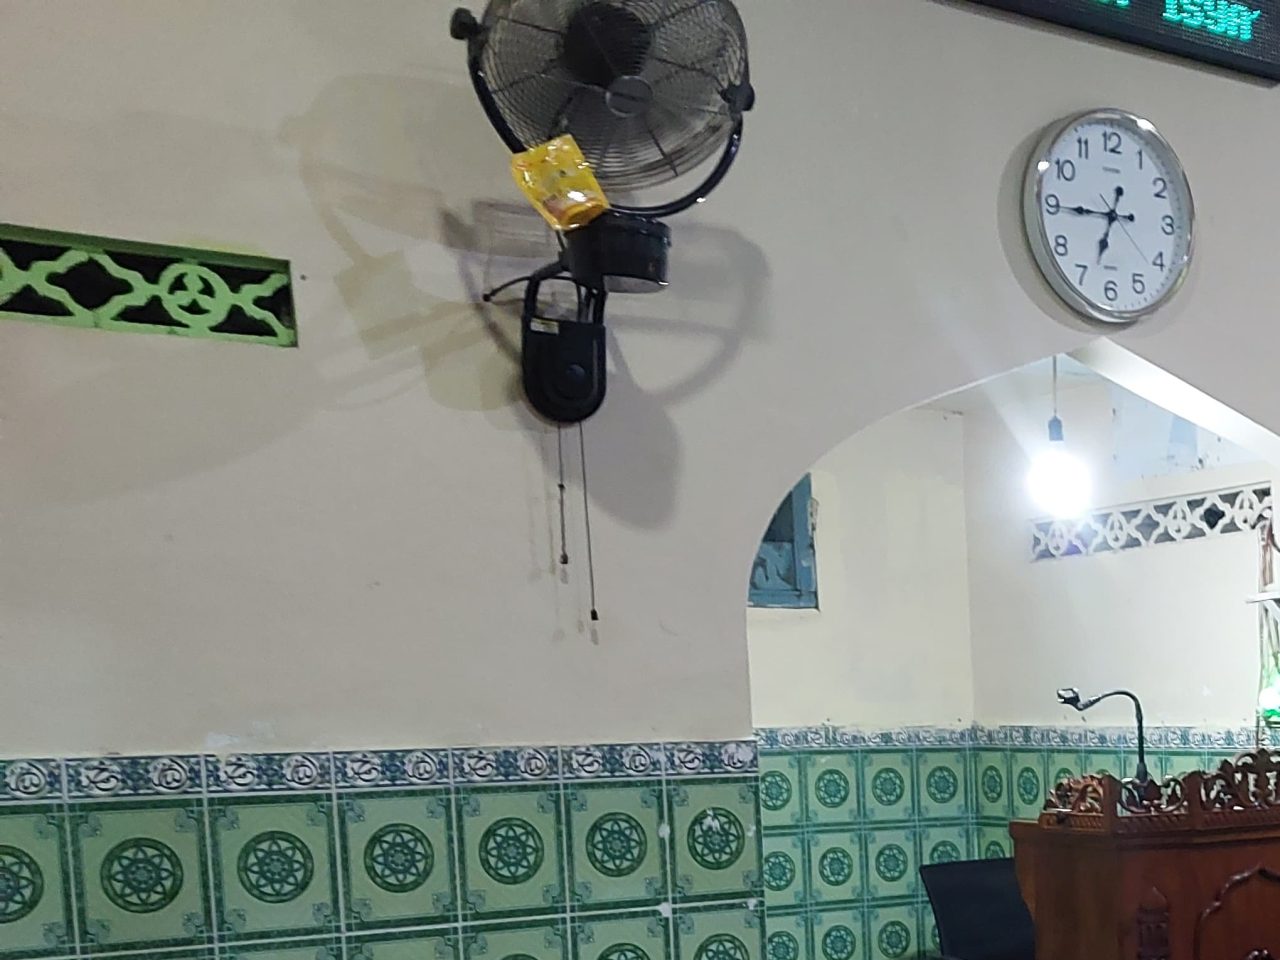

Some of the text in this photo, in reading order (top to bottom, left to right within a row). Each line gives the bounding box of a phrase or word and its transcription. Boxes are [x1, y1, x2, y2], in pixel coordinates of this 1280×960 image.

[1077, 137, 1089, 159] 11
[1102, 131, 1122, 154] 12
[1055, 158, 1076, 181] 10
[1137, 149, 1143, 170] 1
[1152, 177, 1167, 199] 2
[1044, 194, 1060, 215] 9
[1161, 215, 1175, 236] 3
[1054, 235, 1068, 256] 8
[1152, 251, 1165, 272] 4
[1075, 263, 1088, 286] 7
[1132, 273, 1145, 294] 5
[1104, 280, 1118, 301] 6
